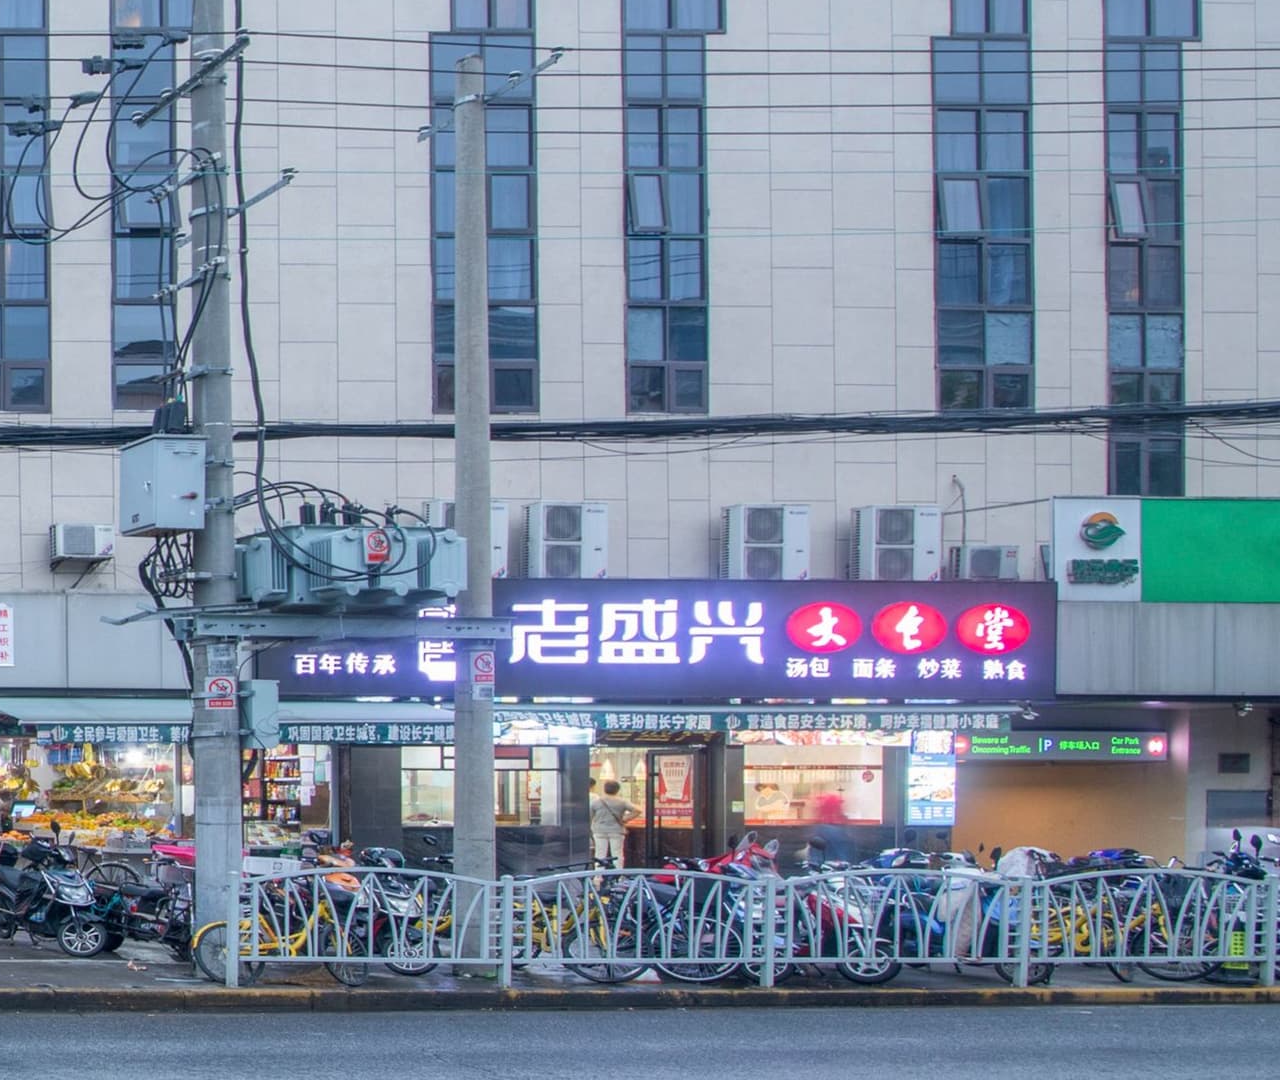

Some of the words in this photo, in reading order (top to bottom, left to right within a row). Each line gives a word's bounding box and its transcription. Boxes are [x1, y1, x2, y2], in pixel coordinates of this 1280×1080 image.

[509, 599, 764, 664] 老盛兴
[294, 653, 397, 675] 百年传承
[786, 657, 831, 678] 汤包
[852, 658, 897, 679] 面条
[917, 658, 962, 679] 炒菜
[983, 660, 1027, 680] 熟食
[971, 736, 1001, 744] Beware
[1002, 736, 1008, 744] of
[1043, 739, 1053, 751] P
[1111, 736, 1123, 745] Car
[1124, 736, 1139, 745] Park
[971, 746, 1009, 755] Oncoming
[1111, 746, 1141, 755] Entrance
